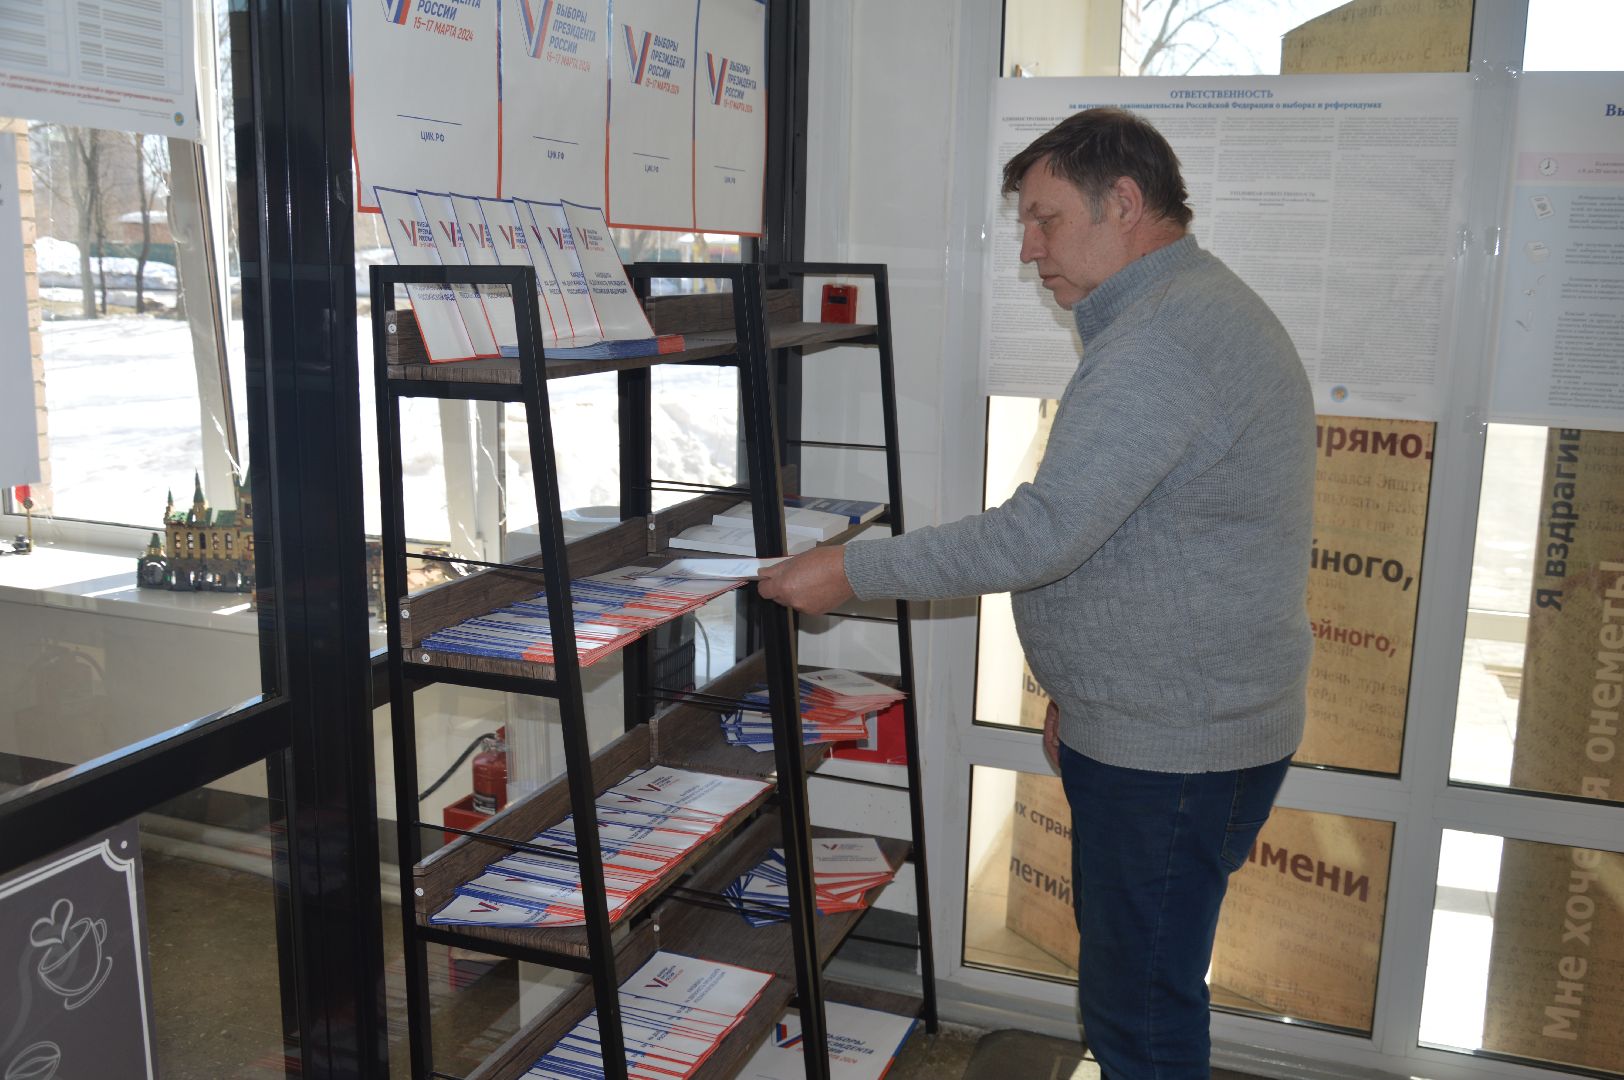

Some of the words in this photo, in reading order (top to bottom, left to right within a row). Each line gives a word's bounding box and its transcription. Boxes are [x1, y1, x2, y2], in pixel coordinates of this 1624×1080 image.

[417, 1, 458, 20] РОССИИ
[556, 4, 588, 24] ВЫБОРЫ
[434, 20, 457, 38] МАРТА
[457, 26, 474, 41] 2024
[552, 19, 597, 42] ПРЕЗИДЕНТА
[549, 36, 578, 54] РОССИИ
[653, 35, 679, 52] ВЫБОРЫ
[650, 49, 686, 69] ПРЕЗИДЕНТА
[728, 60, 751, 75] ВЫБОРЫ
[647, 63, 671, 80] РОССИИ
[727, 73, 757, 90] ПРЕЗИДЕНТА
[724, 86, 745, 100] РОССИИ
[1170, 90, 1274, 99] ОТВЕТСТВЕННОСТЬ
[1231, 102, 1274, 110] Федерации
[1282, 102, 1315, 110] выборах
[1324, 102, 1382, 110] референдумах
[420, 130, 445, 143] ЦИК.РФ
[1535, 588, 1563, 612] Я
[1542, 955, 1589, 1041] Мне
